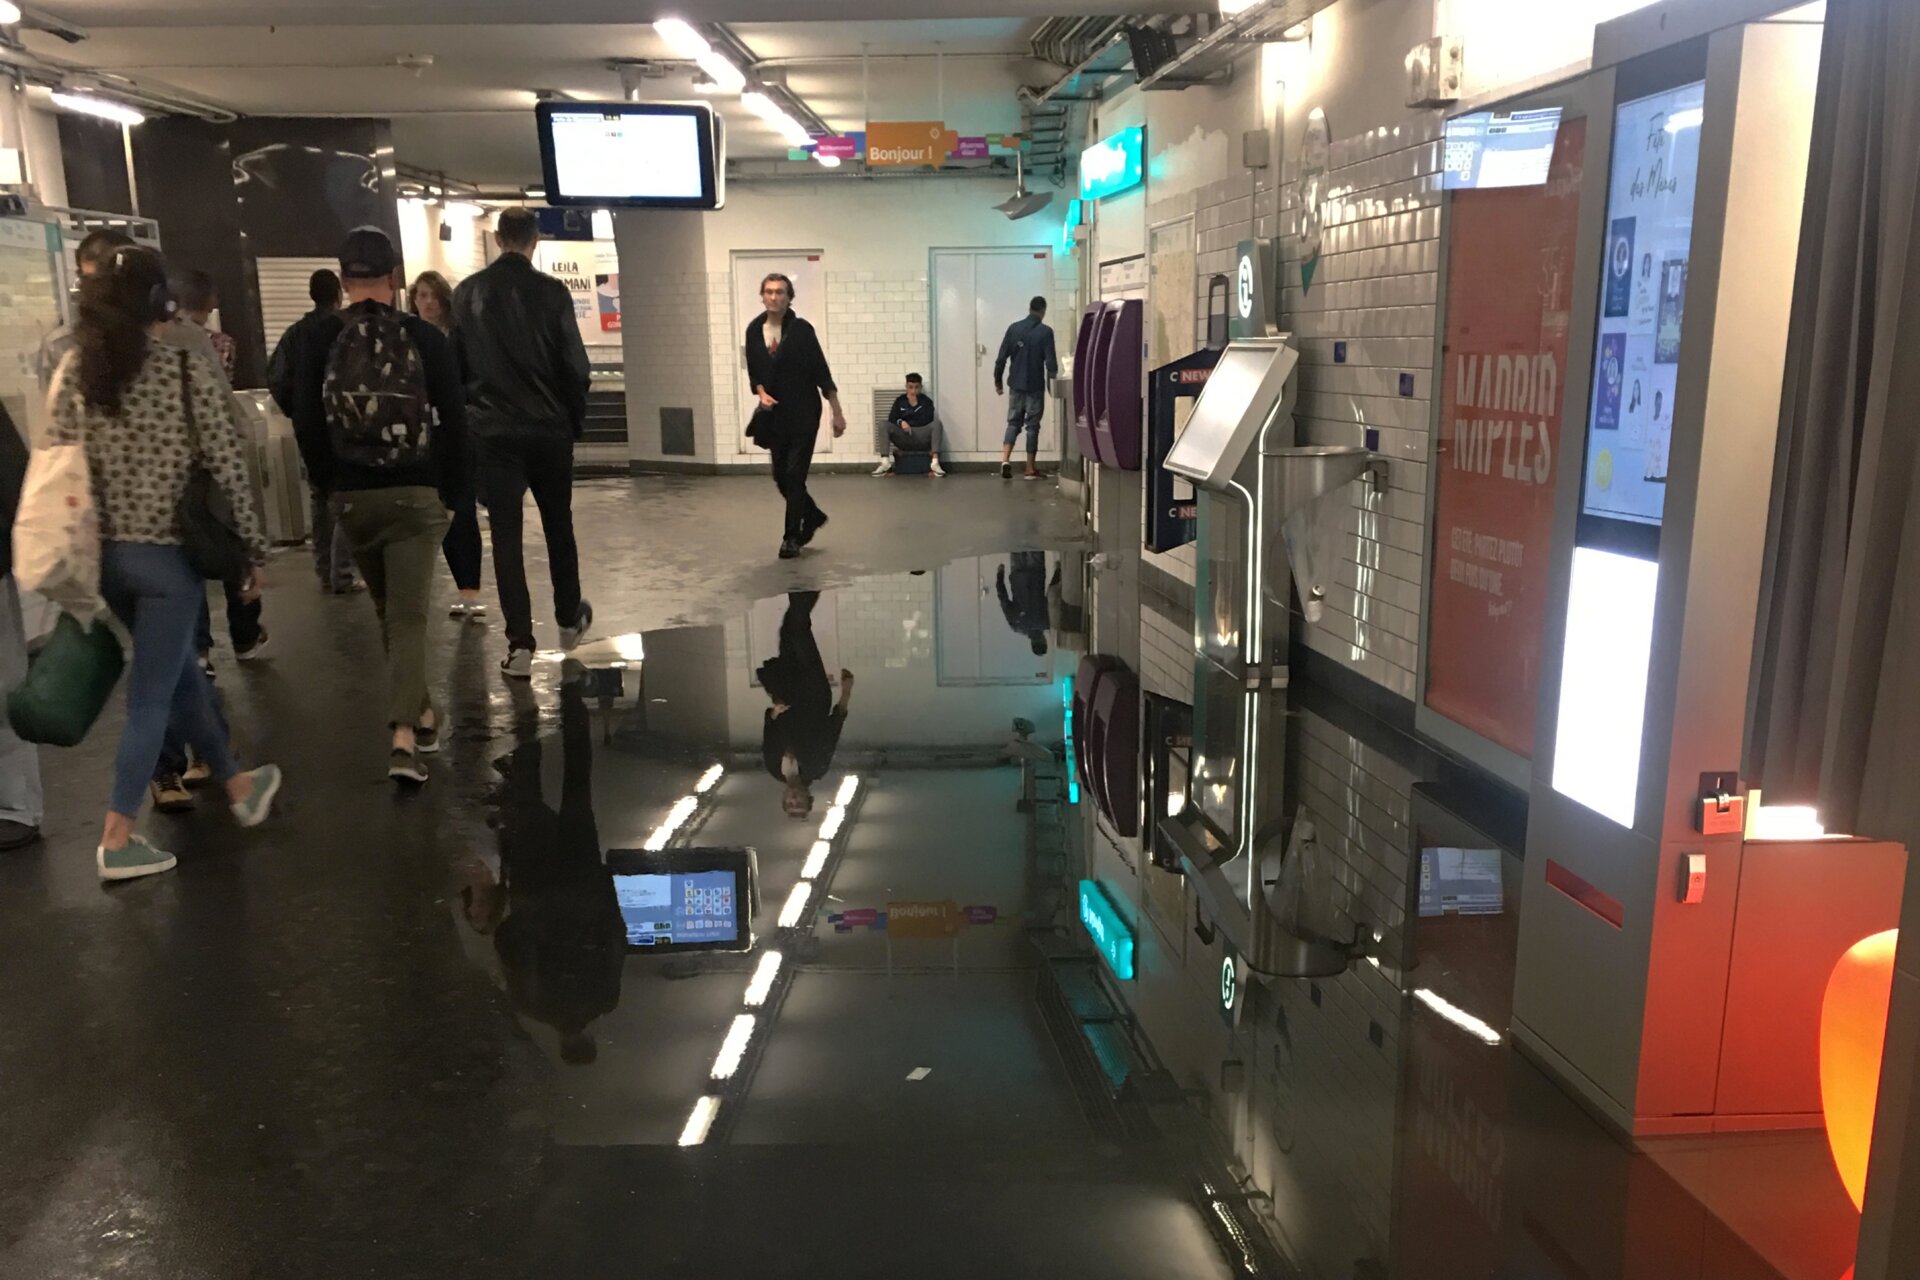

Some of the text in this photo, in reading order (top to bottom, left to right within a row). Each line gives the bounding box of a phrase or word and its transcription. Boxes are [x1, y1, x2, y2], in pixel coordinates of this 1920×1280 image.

[870, 145, 933, 164] Bonjour !
[564, 277, 592, 290] MANI
[1170, 370, 1211, 382] C NEW
[1169, 506, 1197, 518] C NE
